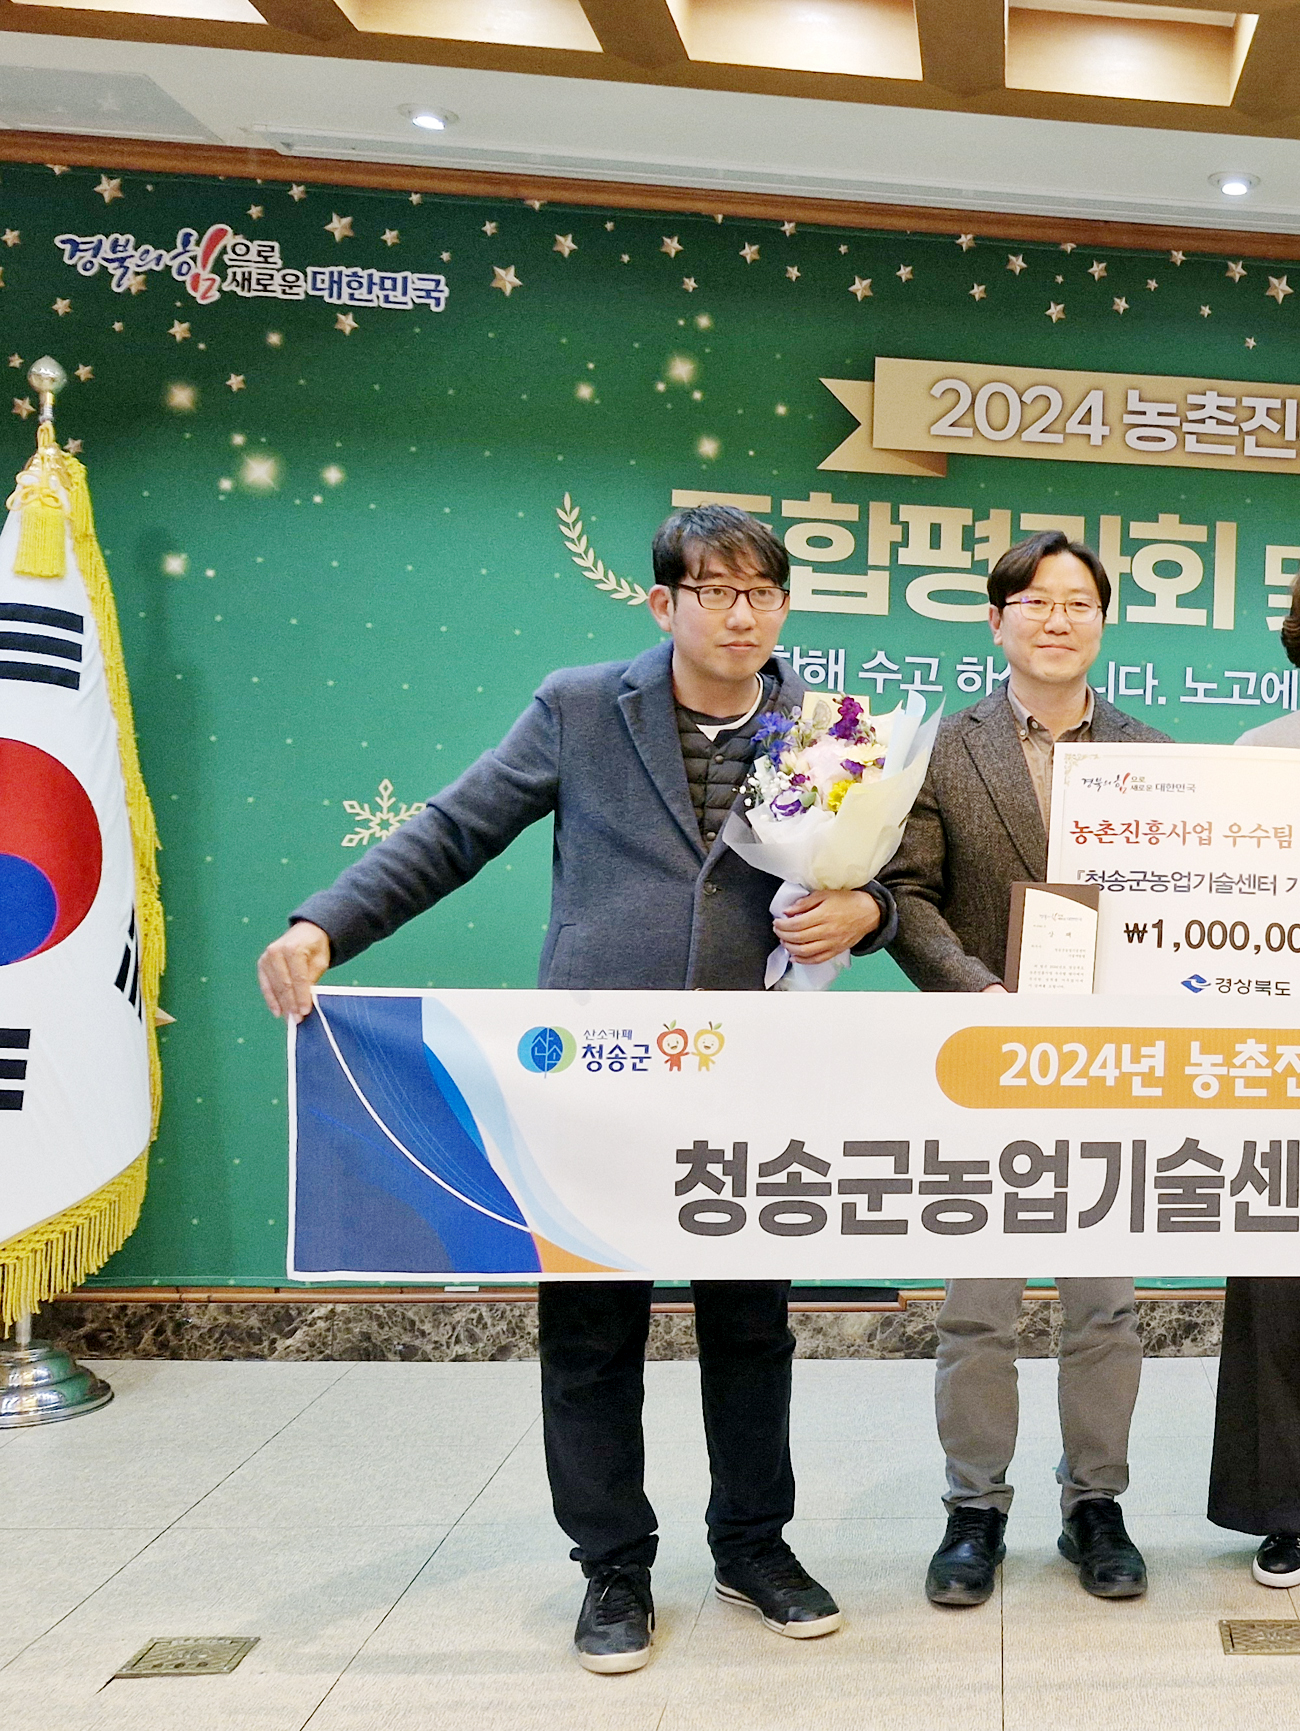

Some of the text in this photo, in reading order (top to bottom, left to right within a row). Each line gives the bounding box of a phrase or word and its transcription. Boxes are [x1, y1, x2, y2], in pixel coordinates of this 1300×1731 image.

[58, 234, 163, 289] 경북의
[228, 269, 446, 309] 새로운 대한민국
[929, 378, 1110, 446] 2024
[671, 489, 1237, 630] 합평가회
[858, 651, 944, 694] 수고
[1180, 667, 1298, 711] 노고에
[1155, 783, 1197, 793] 대한민국
[1069, 819, 1213, 847] 농촌진흥사업
[1222, 822, 1293, 850] 우수팀
[1215, 978, 1291, 997] 경상북도
[583, 1028, 633, 1041] 산소카페
[581, 1043, 652, 1073] 청송군
[999, 1040, 1165, 1097] 2024년
